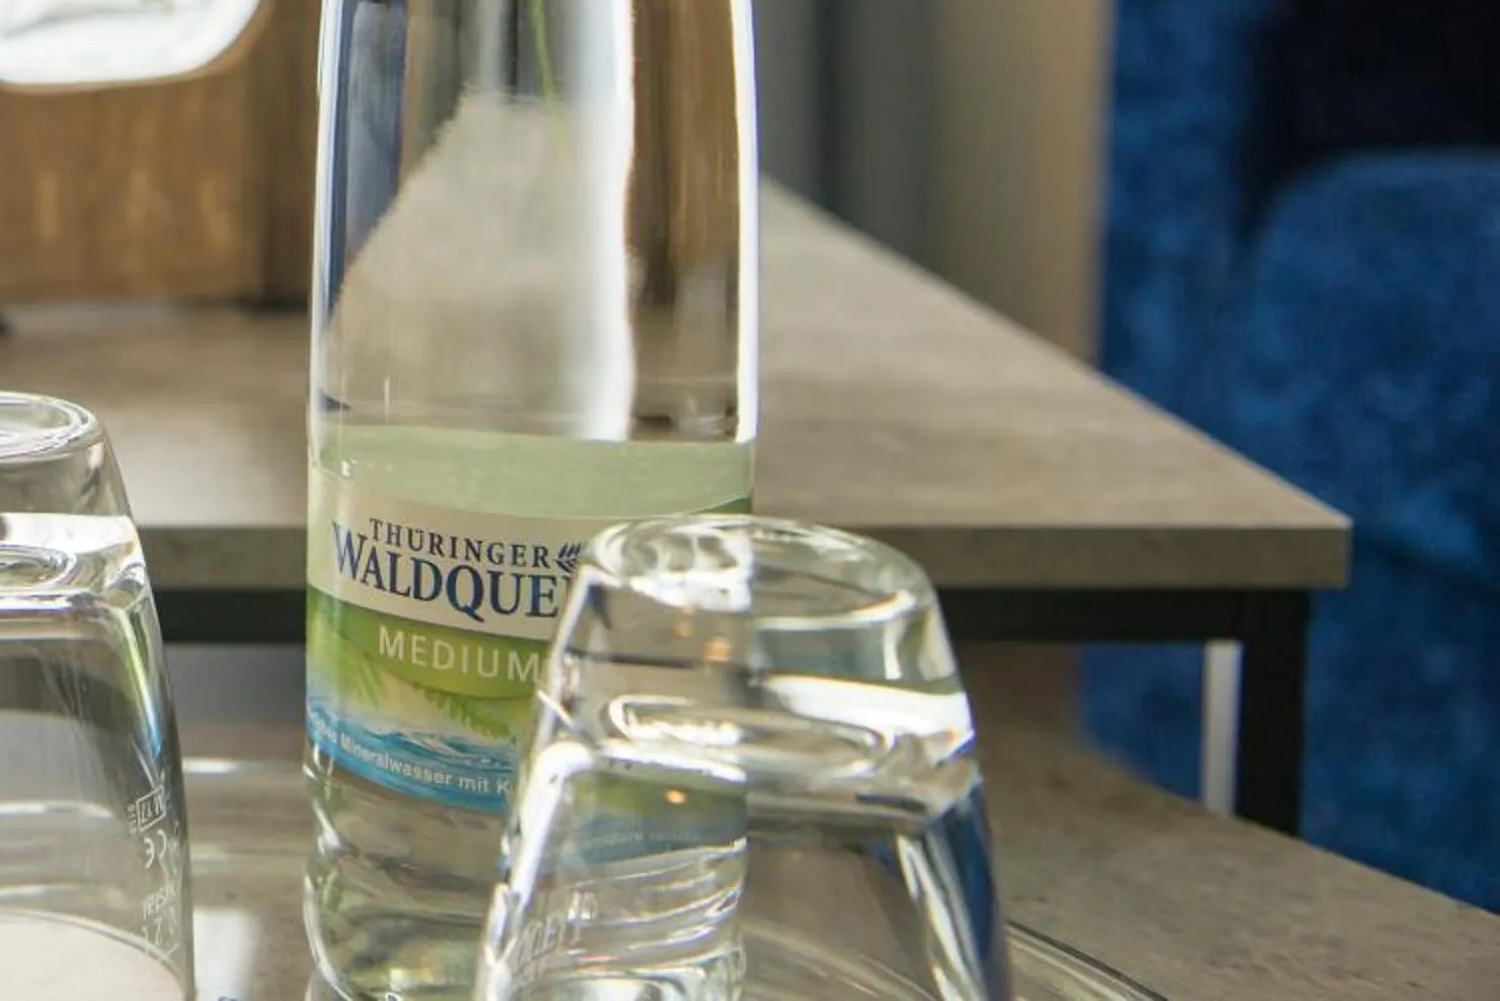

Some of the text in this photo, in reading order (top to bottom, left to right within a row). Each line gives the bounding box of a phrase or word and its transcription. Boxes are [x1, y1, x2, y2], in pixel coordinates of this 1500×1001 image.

[332, 520, 570, 623] WALDQUE
[369, 517, 551, 570] THÜRINGER
[378, 625, 541, 683] MEDIUM
[339, 732, 453, 786] Mineralwasser
[459, 775, 489, 793] mit
